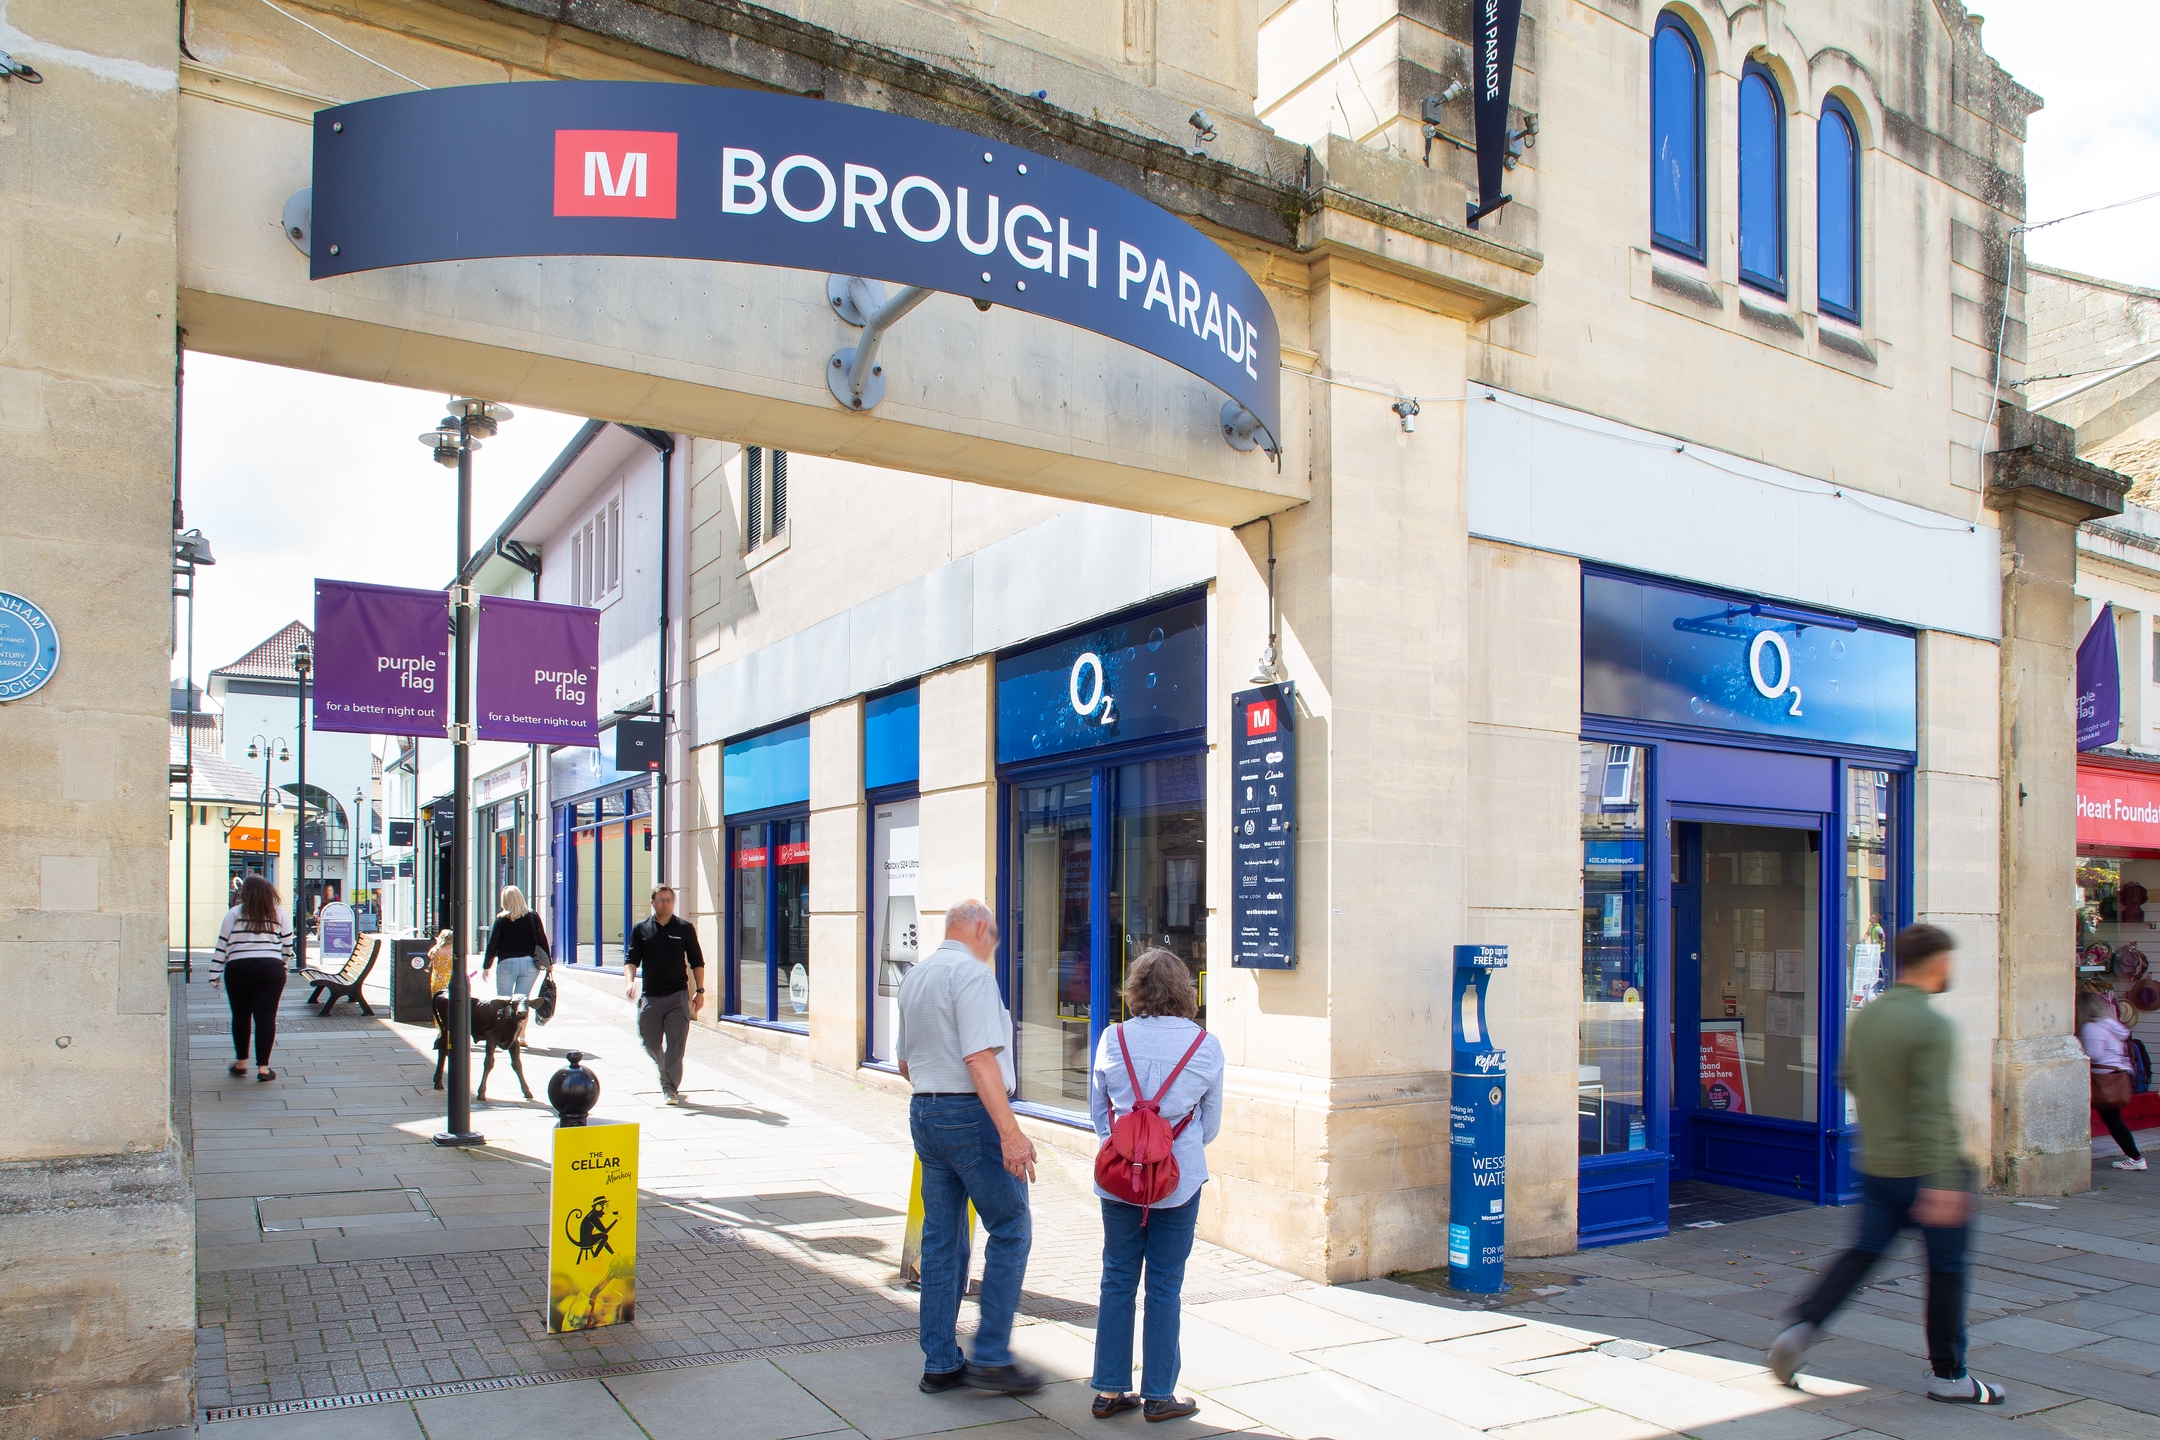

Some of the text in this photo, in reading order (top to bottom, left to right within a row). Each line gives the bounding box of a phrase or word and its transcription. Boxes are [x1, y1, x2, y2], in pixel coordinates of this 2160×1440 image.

[1485, 26, 1499, 102] PARADE
[583, 147, 1258, 381] M BOROUGH PARADE
[378, 655, 436, 672] purple
[534, 669, 588, 685] purple
[1749, 629, 1803, 717] O2
[400, 671, 435, 693] flag
[1070, 652, 1115, 725] O2
[555, 685, 586, 705] flag
[2076, 691, 2095, 705] rple
[326, 701, 436, 718] for a better night out
[488, 711, 502, 722] for
[512, 713, 542, 724] better
[544, 715, 569, 727] night
[570, 717, 587, 727] out
[1254, 708, 1269, 728] M
[2083, 723, 2099, 733] night
[2099, 720, 2110, 728] out
[2077, 731, 2100, 743] ENHAM
[1264, 770, 1284, 780] Clarks
[2077, 794, 2112, 820] Heart
[878, 811, 892, 819] SAMSUNG
[306, 863, 336, 873] OOK
[884, 861, 900, 872] Galaxy
[1063, 880, 1092, 889] broadban
[1246, 908, 1277, 916] wetherspoon
[1480, 946, 1494, 957] Top
[1495, 948, 1502, 956] up
[1473, 956, 1493, 965] FREE
[1494, 957, 1504, 966] tap
[1475, 1052, 1500, 1073] Refill
[571, 1157, 620, 1171] CELLAR
[605, 1171, 632, 1185] Monkey
[1473, 1171, 1505, 1187] WATE
[1482, 1247, 1496, 1255] FOR
[1482, 1256, 1496, 1264] FOR
